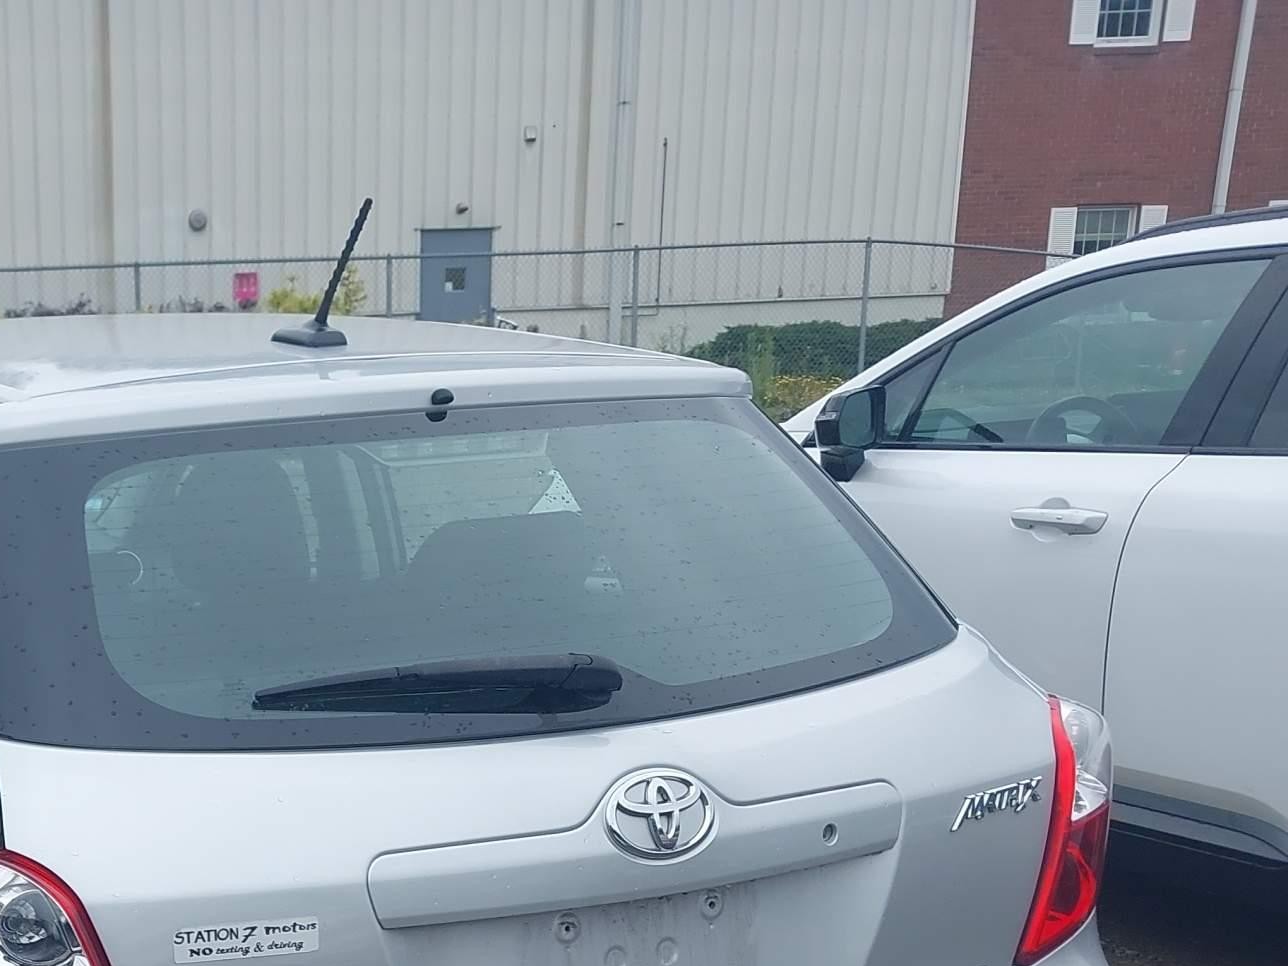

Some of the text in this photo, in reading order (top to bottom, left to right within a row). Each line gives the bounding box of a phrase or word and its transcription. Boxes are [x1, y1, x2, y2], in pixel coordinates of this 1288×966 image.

[173, 921, 317, 945] STATION 7 motors
[188, 940, 304, 958] NO texting & driving
